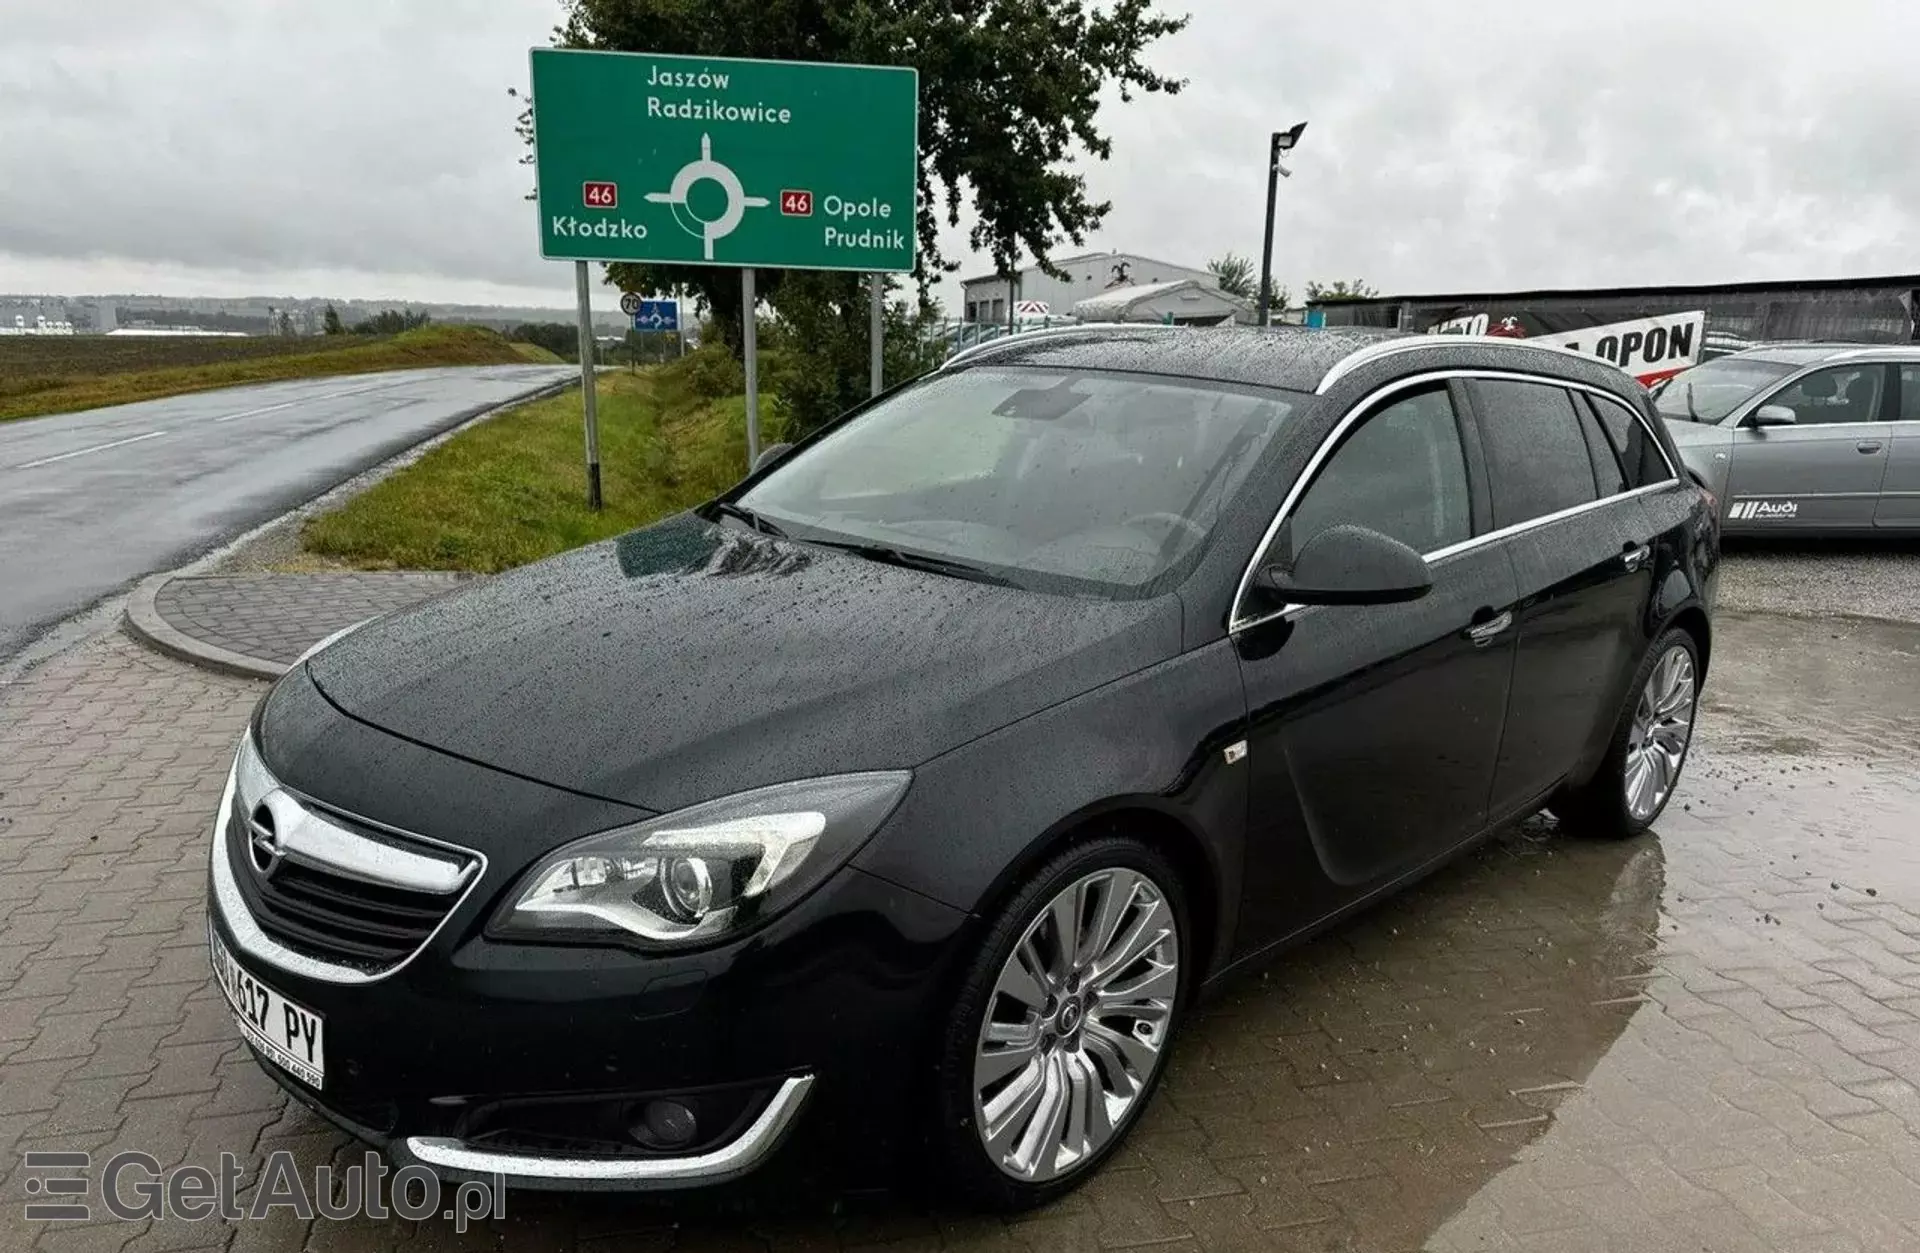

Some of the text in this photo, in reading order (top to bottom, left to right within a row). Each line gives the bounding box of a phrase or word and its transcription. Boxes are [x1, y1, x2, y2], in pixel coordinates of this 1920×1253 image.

[647, 65, 730, 89] Jaszów
[647, 97, 792, 124] Radzikowice
[588, 187, 613, 205] 46
[785, 194, 809, 212] 46
[824, 195, 892, 221] Opole
[552, 216, 648, 240] Kłodzko
[824, 227, 905, 250] Prudnik
[1595, 322, 1695, 367] OPON
[1757, 501, 1798, 513] Audi
[283, 1002, 316, 1064] PY
